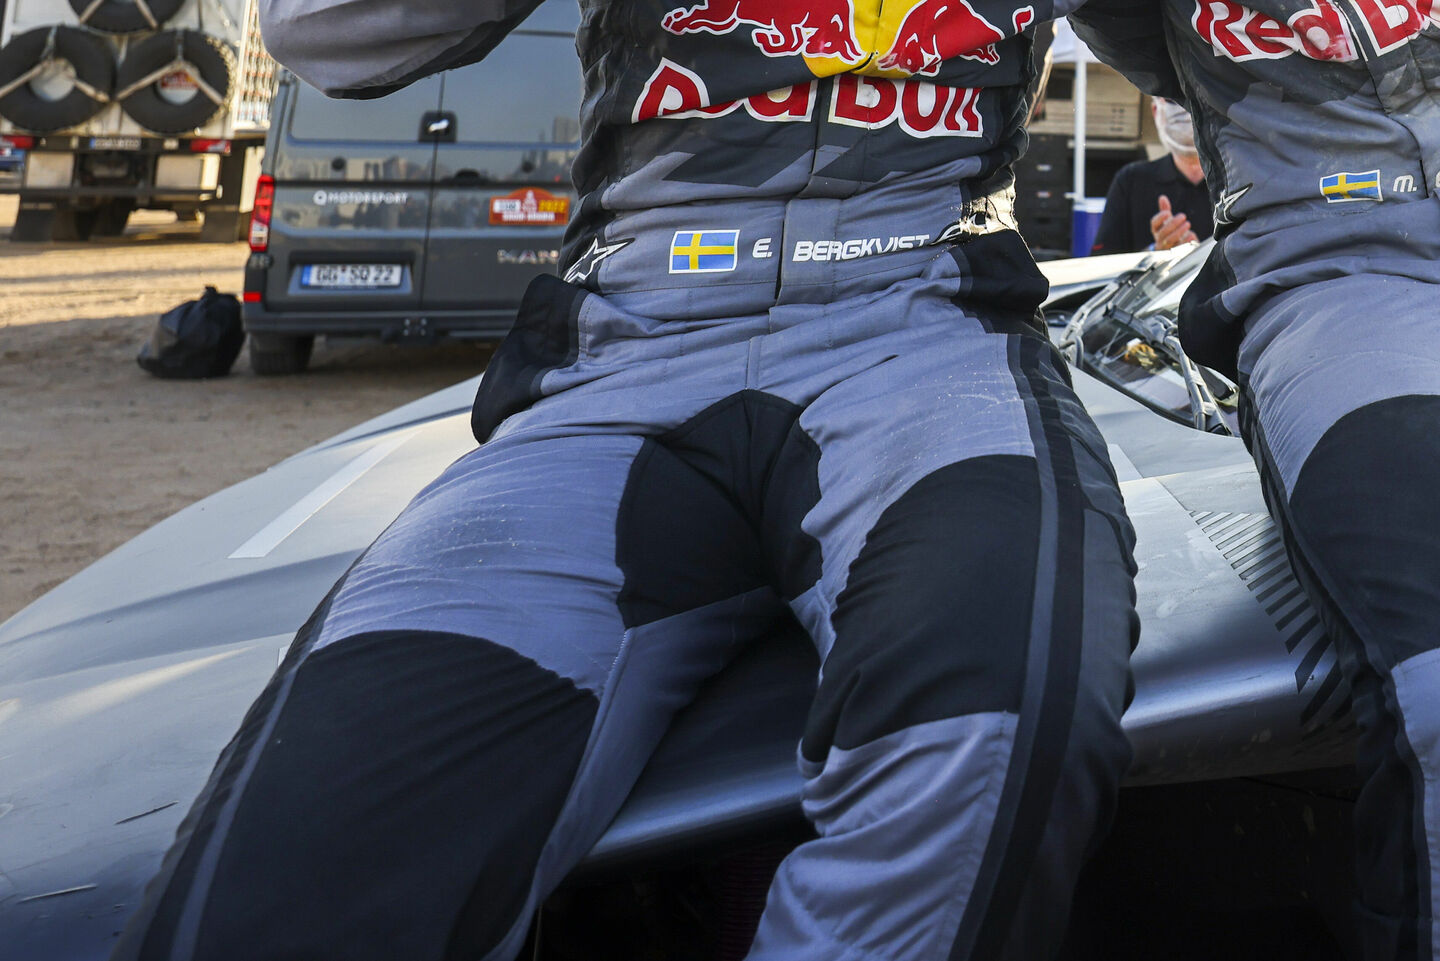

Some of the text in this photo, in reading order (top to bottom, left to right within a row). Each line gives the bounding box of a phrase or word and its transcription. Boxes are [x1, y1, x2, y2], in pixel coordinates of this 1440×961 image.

[631, 57, 984, 138] Rd Bull
[792, 234, 930, 262] BERGKVIST
